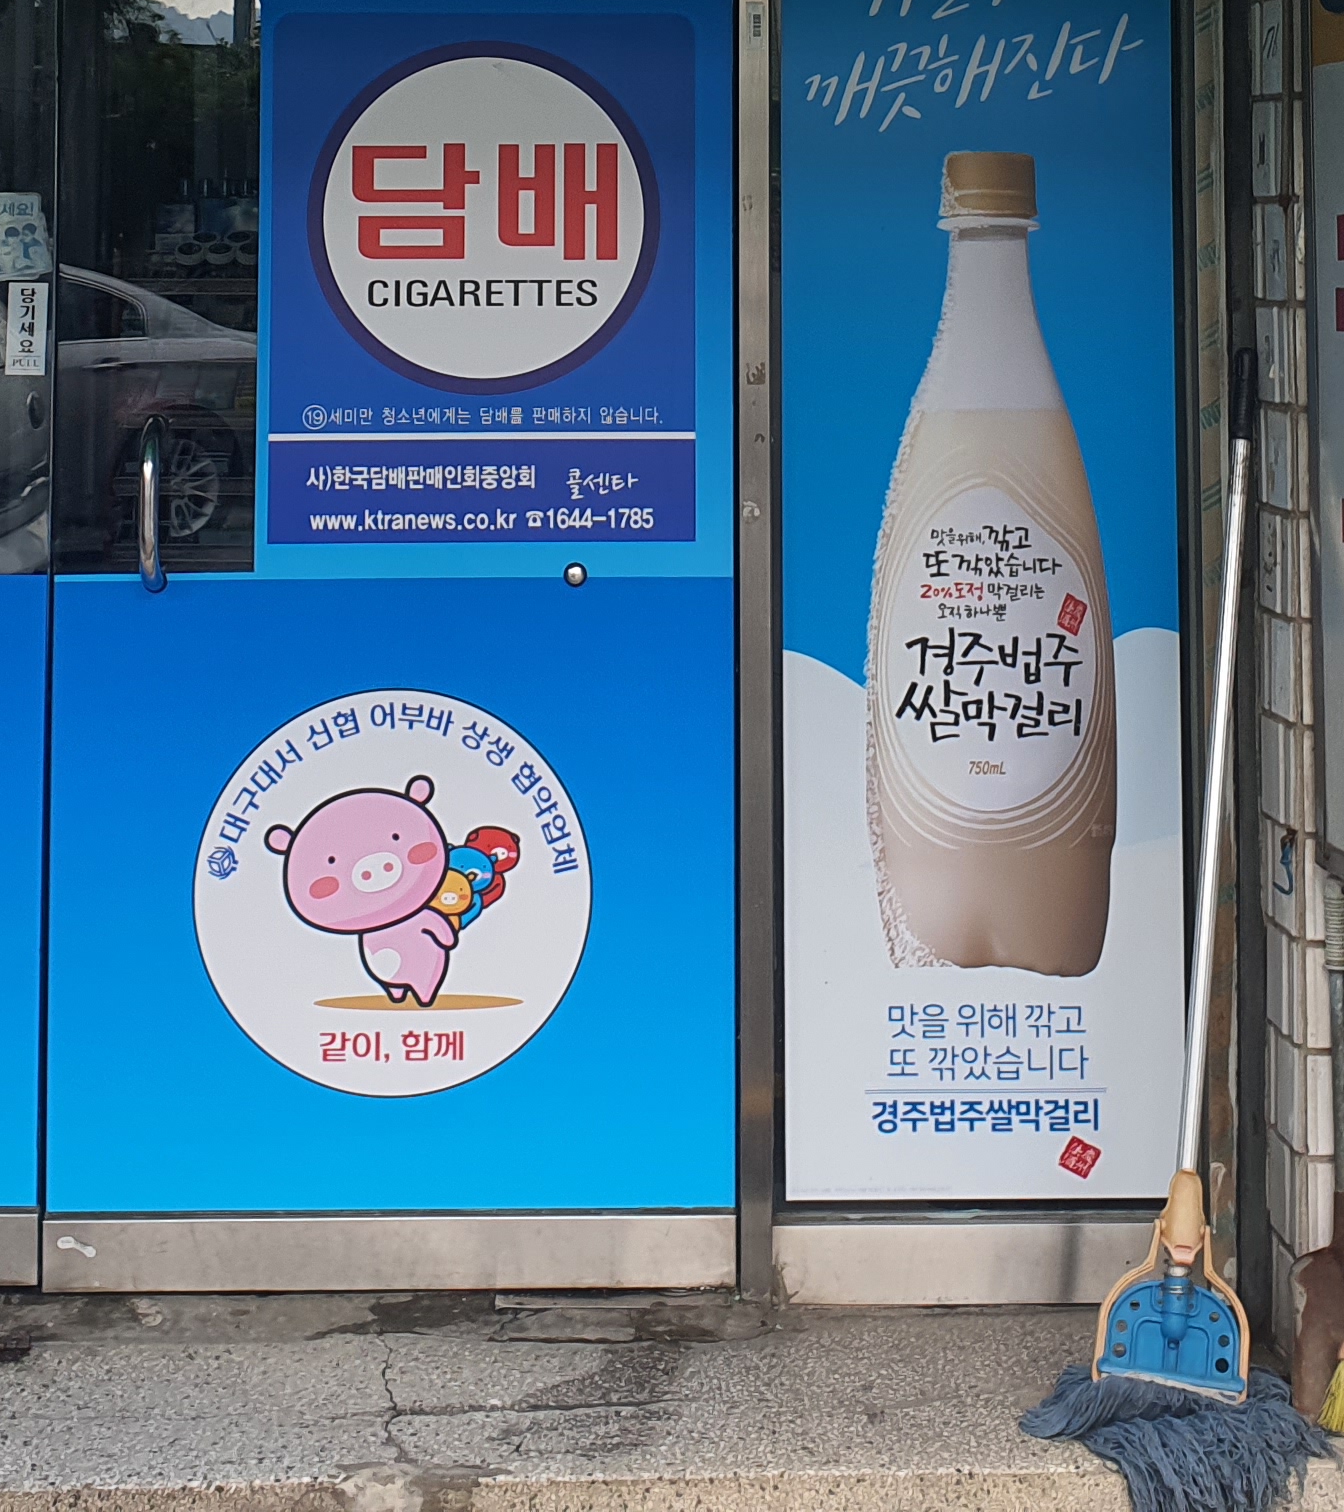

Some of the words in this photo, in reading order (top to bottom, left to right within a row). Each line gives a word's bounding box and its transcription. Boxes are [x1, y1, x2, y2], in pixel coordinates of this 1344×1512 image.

[805, 13, 1144, 133] 깨끗해진다
[352, 143, 618, 261] 담배
[367, 279, 598, 307] CIGARETTES
[18, 288, 37, 353] 당기세요
[382, 407, 472, 425] 청소년에게는
[479, 407, 523, 425] 담배를
[532, 406, 592, 425] 판매하지
[565, 468, 639, 500] 콜센타
[310, 509, 517, 532] www.ktranews.co.kr
[905, 627, 1083, 688] 경주법주
[895, 680, 1083, 742] 쌀막걸리
[968, 760, 1007, 776] 750mL
[219, 739, 306, 843] 대구대서
[306, 707, 361, 751] 신협
[370, 702, 455, 737] 어부바
[461, 720, 516, 767] 상생
[511, 761, 579, 874] 협약업체
[887, 1003, 949, 1039] 맛을
[956, 1003, 1017, 1038] 위해
[1024, 1003, 1087, 1038] 깎고
[319, 1031, 391, 1063] 같이,
[402, 1030, 464, 1061] 함께
[886, 1048, 919, 1077] 또
[928, 1045, 1089, 1081] 깎았습니다
[871, 1099, 1100, 1133] 경주법주쌀막걸리
